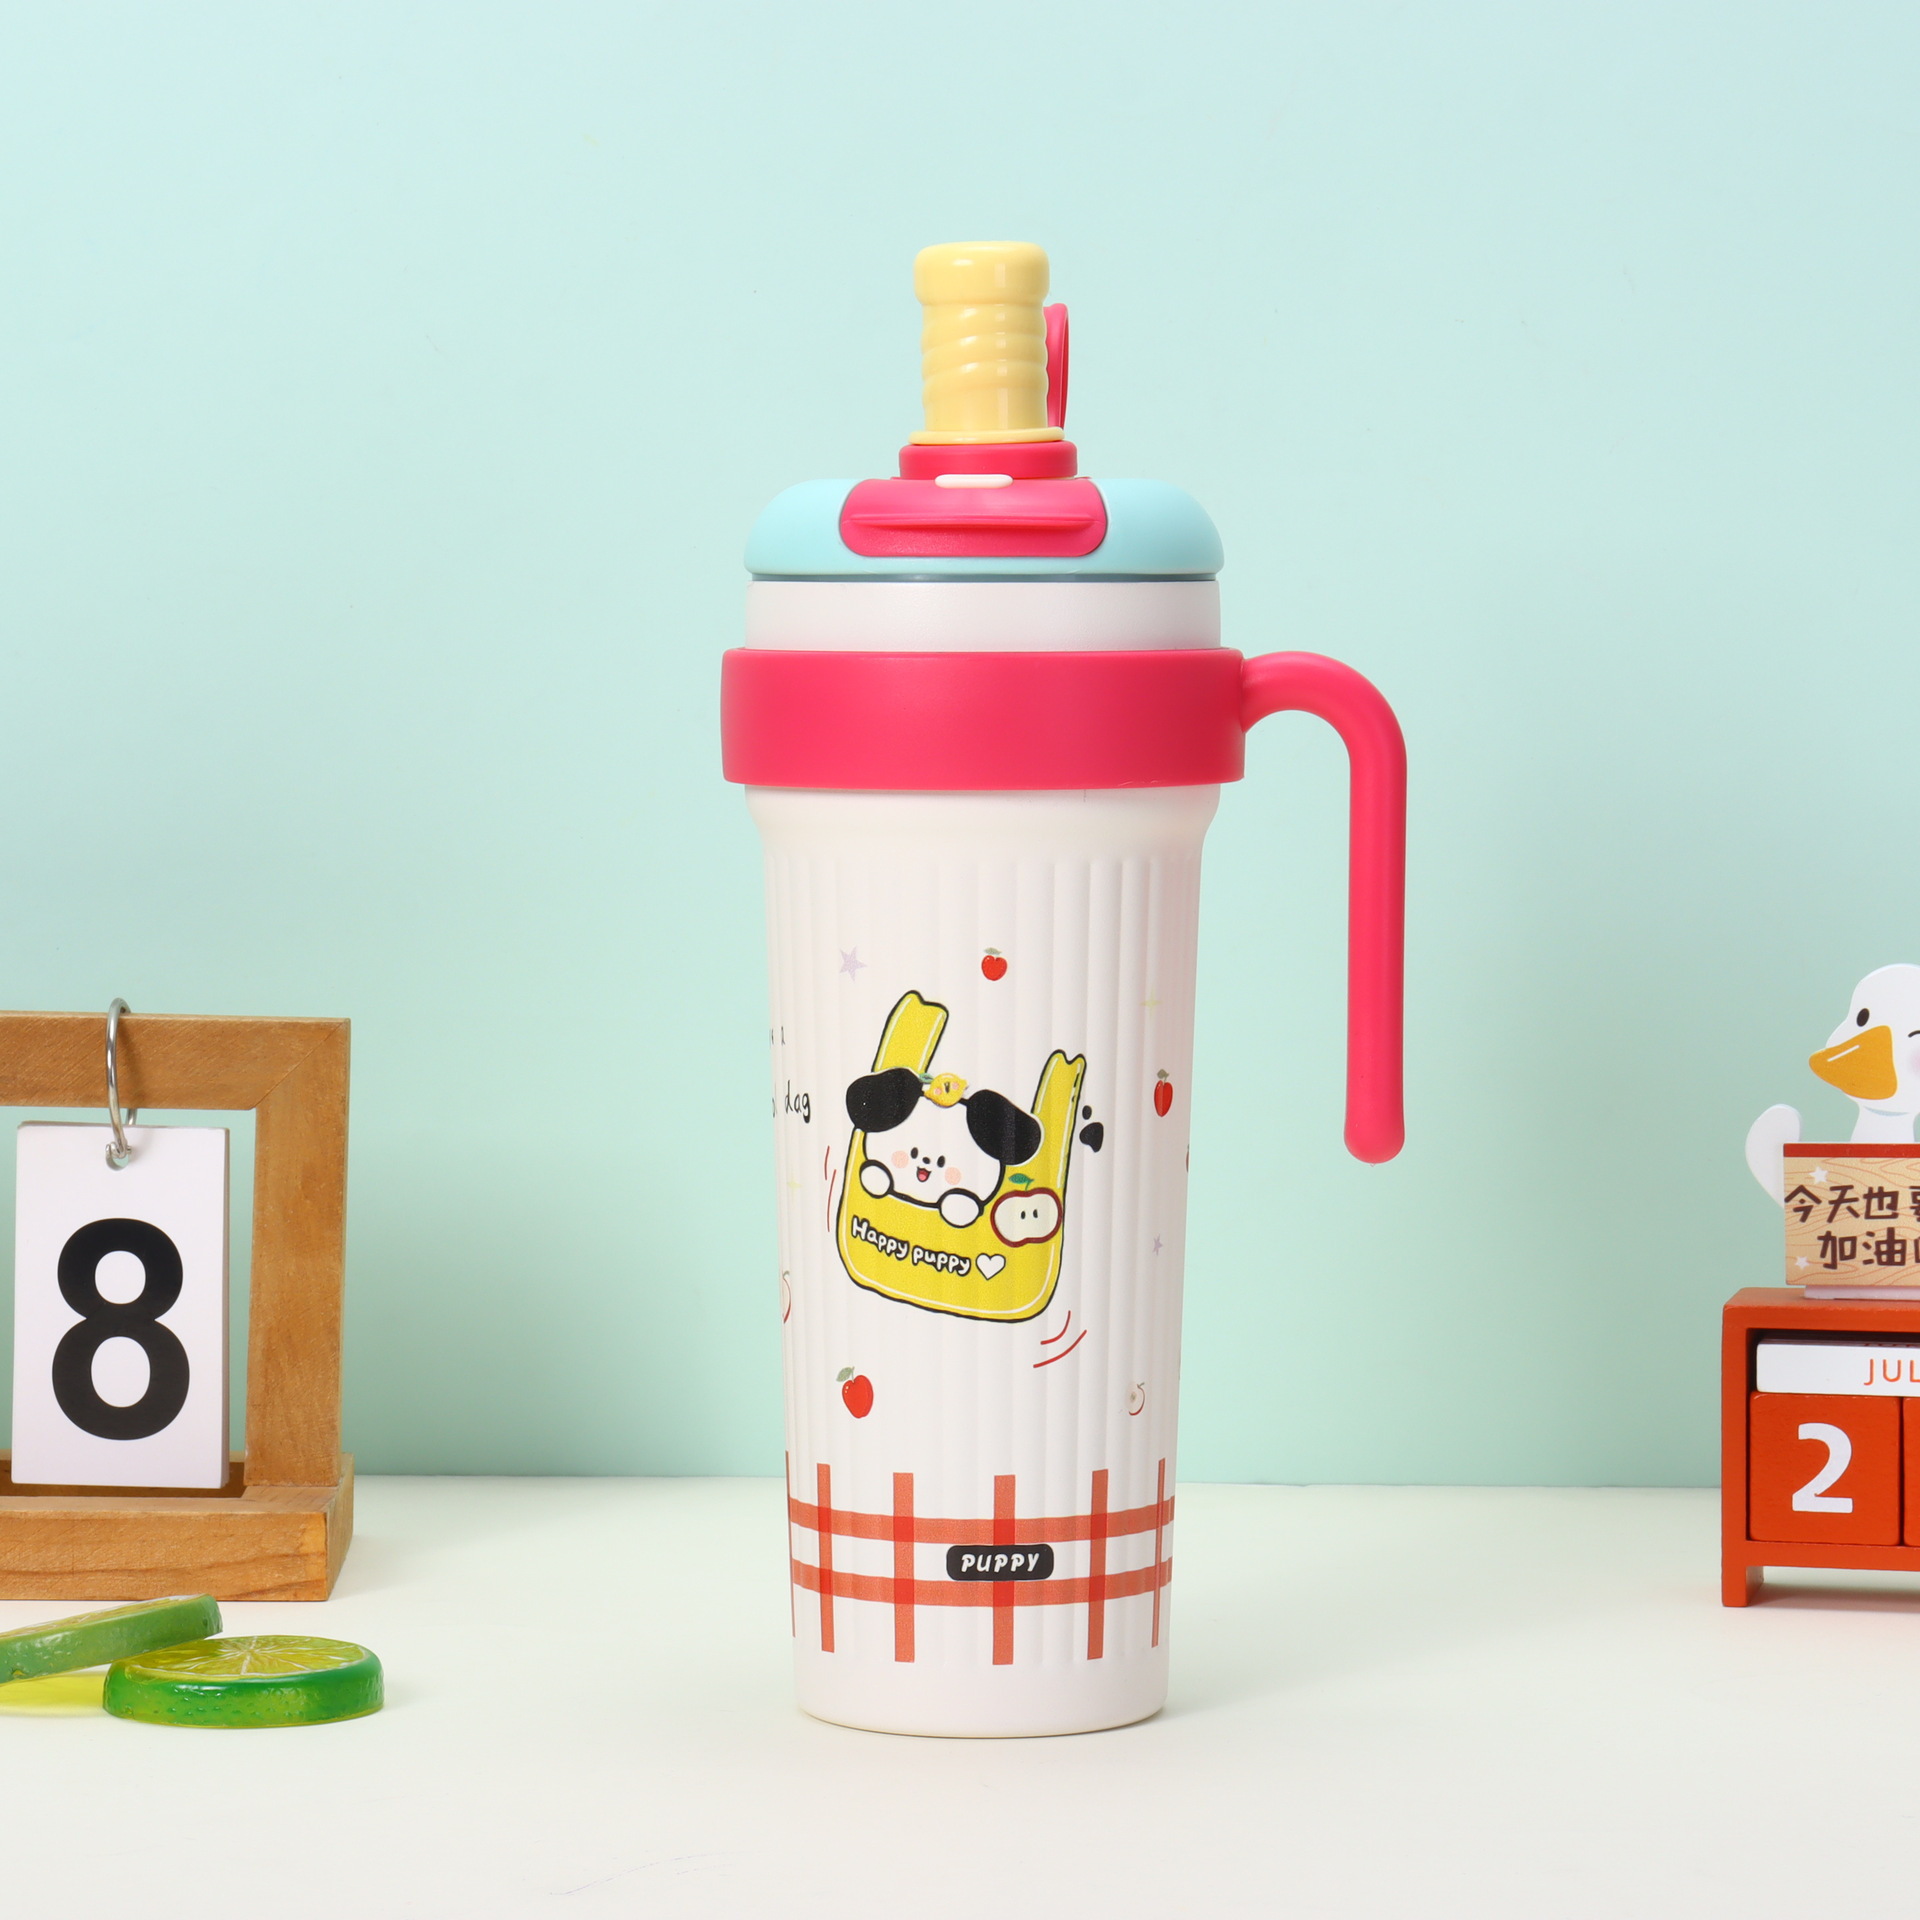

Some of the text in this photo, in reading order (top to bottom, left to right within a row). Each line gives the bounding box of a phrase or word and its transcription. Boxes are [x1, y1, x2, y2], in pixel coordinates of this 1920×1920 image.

[851, 1215, 971, 1277] Happy puppy
[1817, 1227, 1920, 1270] 加油
[52, 1217, 190, 1441] 8
[1792, 1422, 1853, 1513] 2
[960, 1552, 1040, 1573] PUPPY
